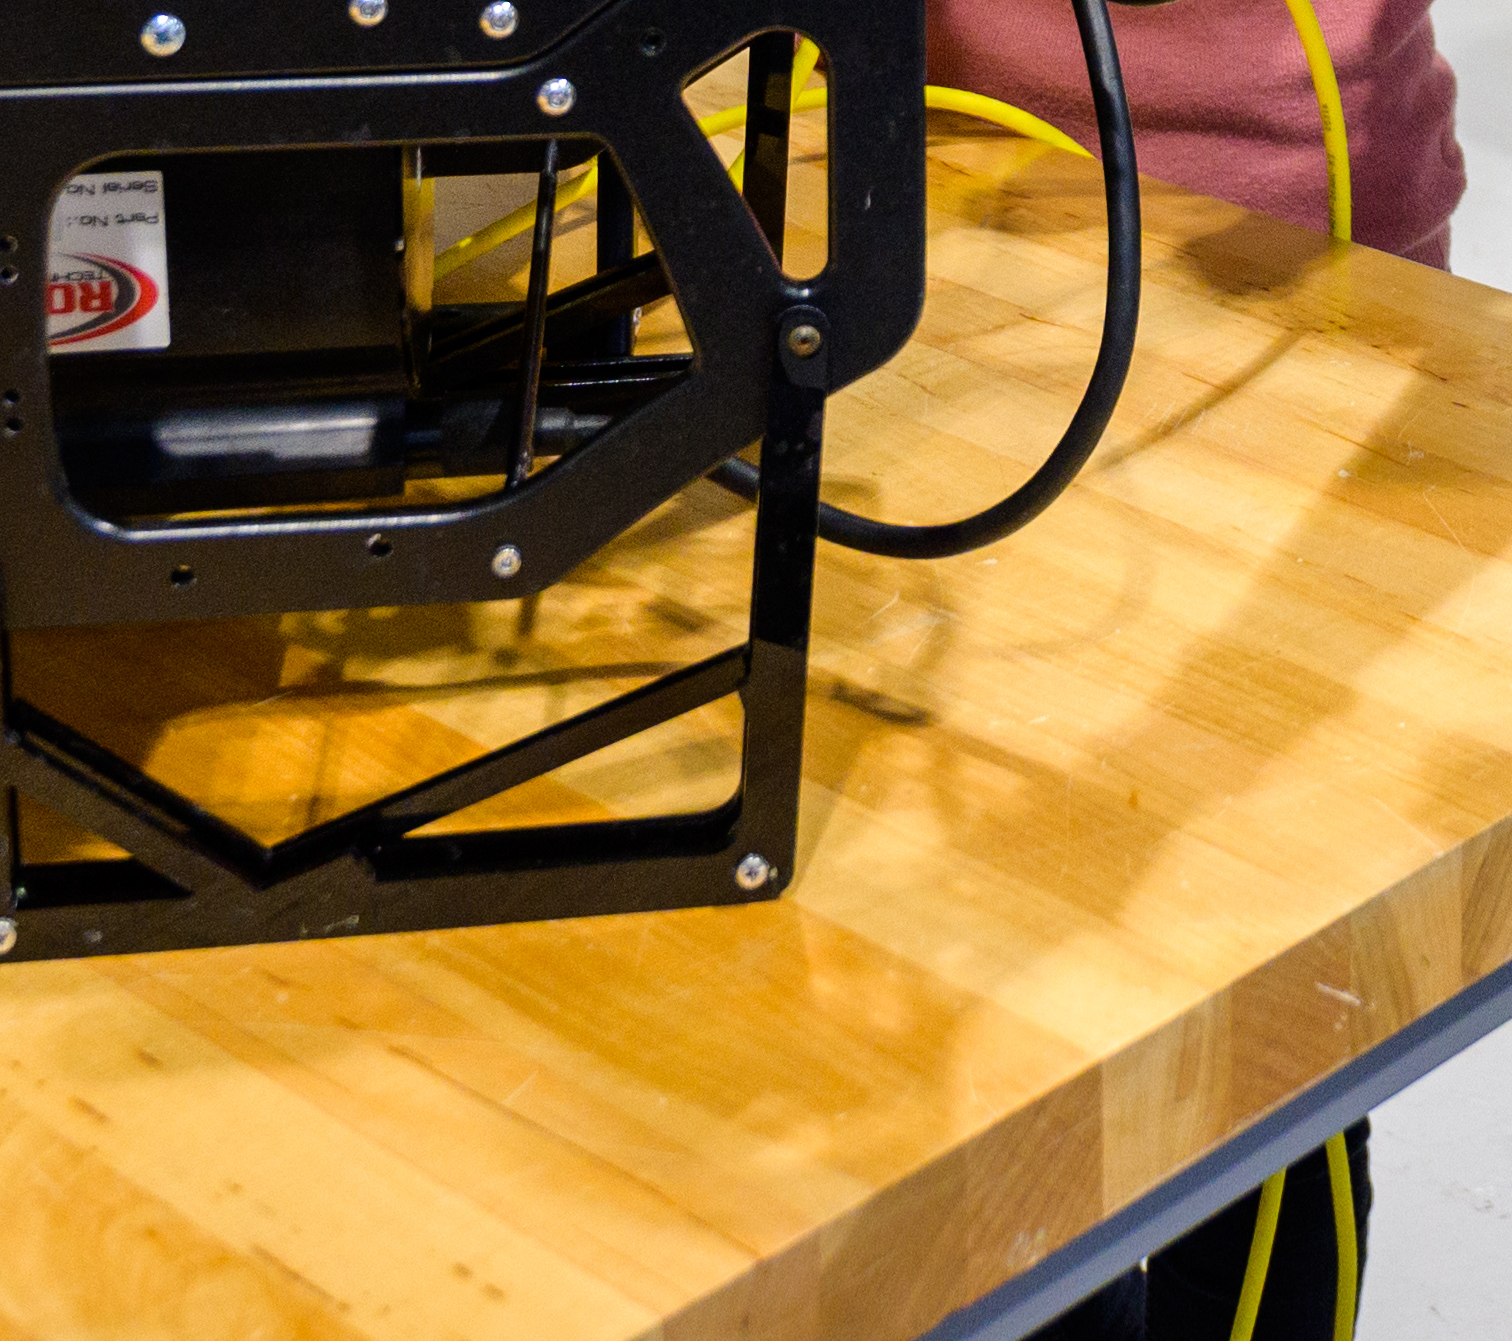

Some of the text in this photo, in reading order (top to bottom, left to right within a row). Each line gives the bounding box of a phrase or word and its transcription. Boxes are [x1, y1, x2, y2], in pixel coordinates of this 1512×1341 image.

[103, 180, 159, 195] Serial
[115, 212, 160, 225] Part
[47, 281, 112, 314] RO
